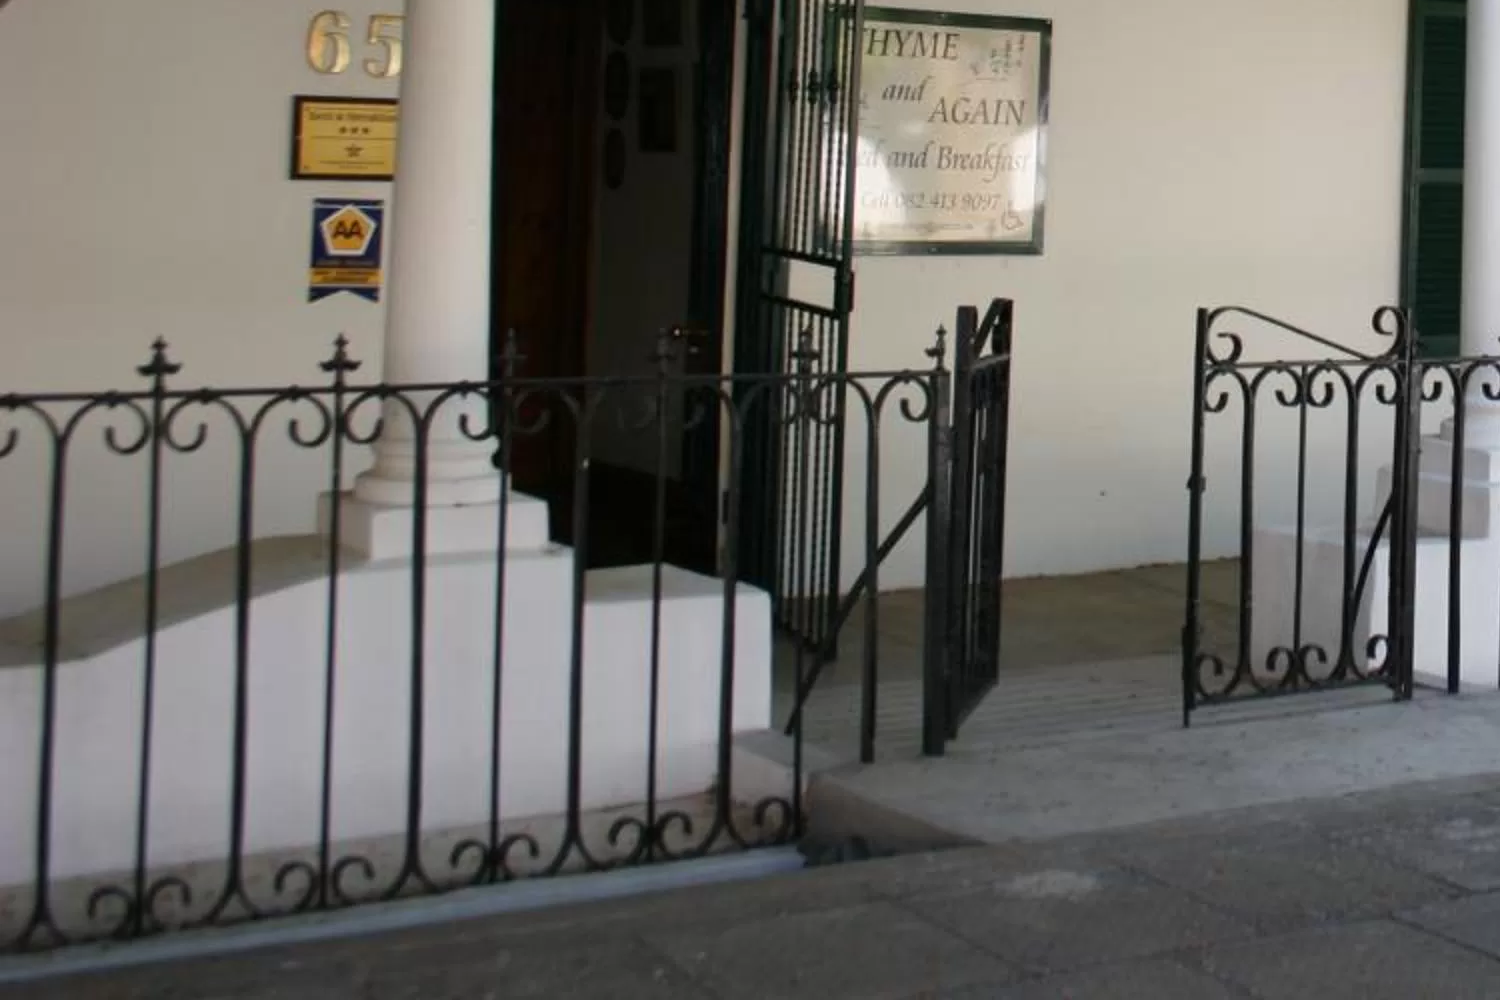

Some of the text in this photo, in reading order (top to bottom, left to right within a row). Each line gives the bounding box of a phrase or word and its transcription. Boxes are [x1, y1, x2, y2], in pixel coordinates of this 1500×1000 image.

[305, 9, 405, 79] 65
[881, 75, 932, 101] and
[927, 97, 1026, 126] AGAIN
[886, 139, 934, 169] and
[936, 143, 1029, 183] Breakfast
[331, 219, 365, 241] AA
